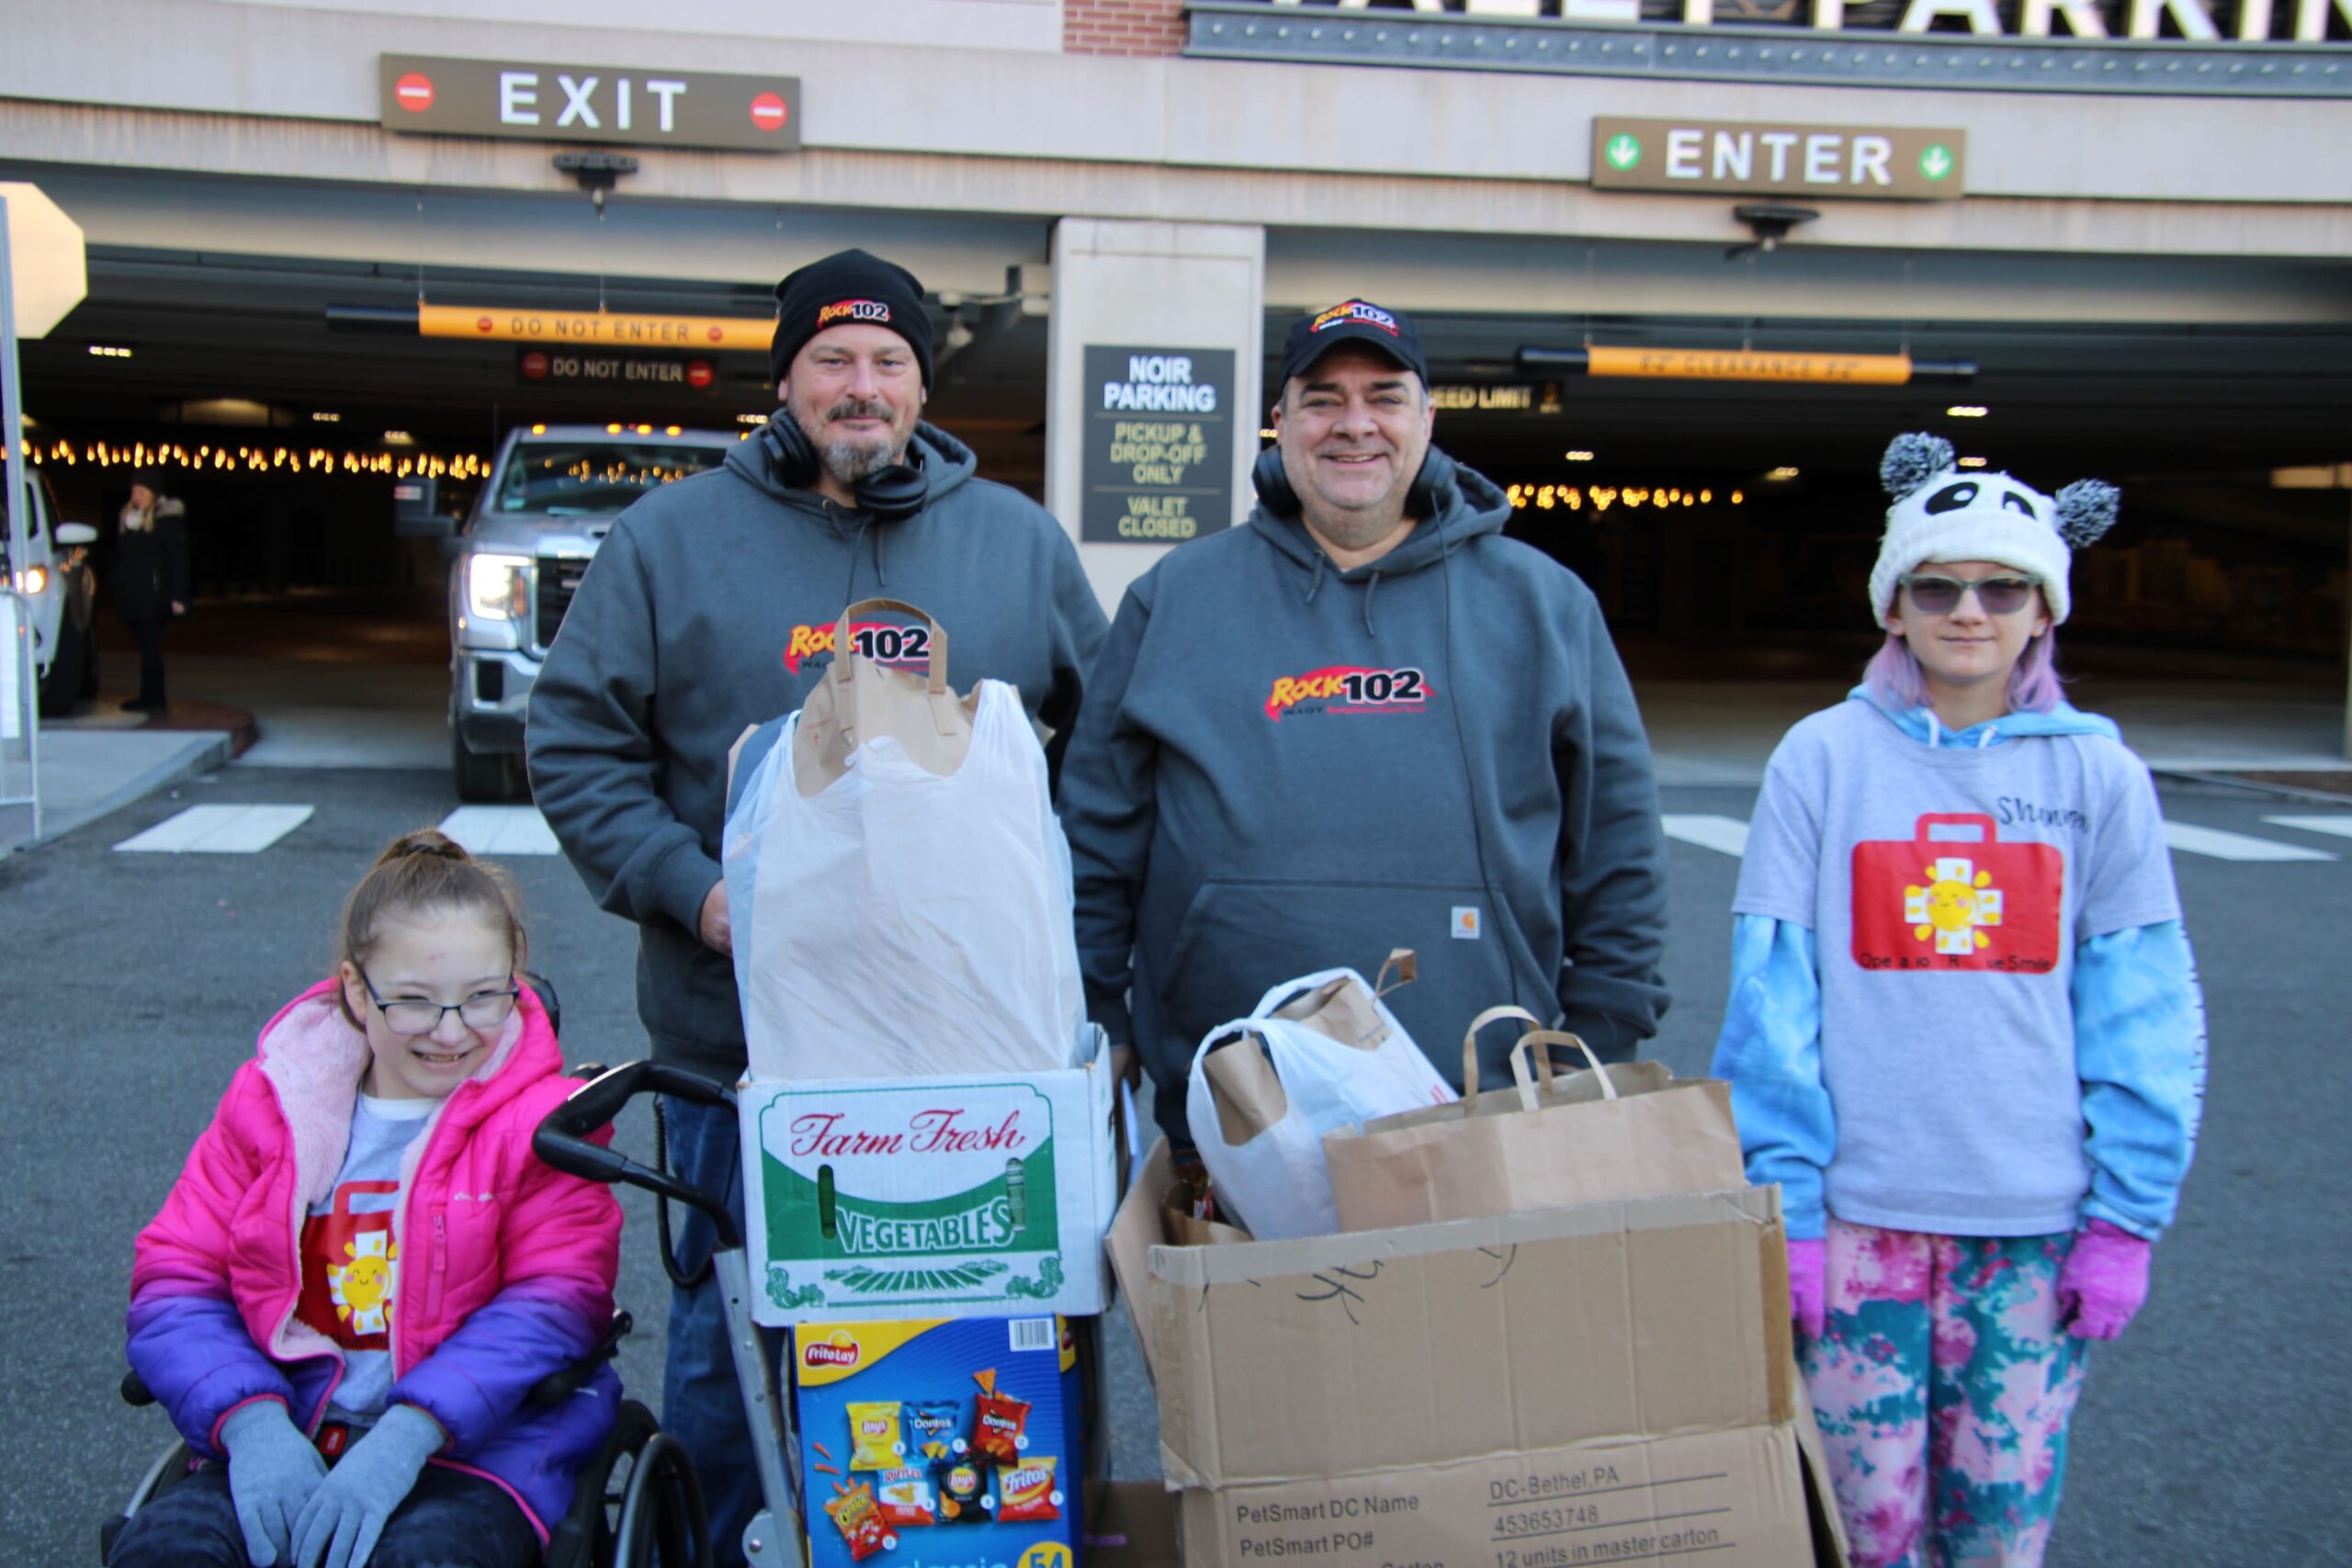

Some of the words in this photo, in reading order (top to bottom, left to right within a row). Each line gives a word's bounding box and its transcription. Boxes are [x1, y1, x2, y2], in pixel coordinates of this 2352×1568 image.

[500, 72, 686, 132] EXIT
[1666, 129, 1893, 185] ENTER
[852, 300, 888, 322] 102
[511, 318, 543, 336] DO
[556, 320, 601, 338] NOT
[615, 321, 690, 342] ENTER
[553, 361, 584, 378] DO
[589, 363, 620, 378] NOT
[625, 365, 684, 382] ENTER
[1129, 355, 1192, 384] NOIR
[1104, 382, 1216, 412] PARKING
[1479, 385, 1532, 409] LIMIT
[1114, 422, 1185, 444] PICKUP
[1188, 424, 1204, 444] &
[1110, 443, 1207, 465] DROP-OFF
[1133, 464, 1185, 484] ONLY
[1127, 496, 1189, 516] VALET
[1118, 516, 1196, 538] CLOSED
[854, 626, 930, 662] 102
[1341, 667, 1426, 705] 102
[790, 1112, 903, 1157] Farm
[910, 1108, 1025, 1154] Fresh
[834, 1196, 1014, 1255] VEGETABLES
[1005, 1468, 1049, 1494] Fritos
[1237, 1504, 1325, 1523] PetSmart
[1329, 1498, 1359, 1518] DC
[1364, 1495, 1419, 1515] Name
[1495, 1505, 1599, 1535] 453653748
[1240, 1536, 1328, 1557] PetSmart
[1333, 1531, 1374, 1551] PO#
[1497, 1551, 1515, 1568] 12
[1521, 1544, 1566, 1565] units
[1572, 1543, 1589, 1560] in
[1593, 1537, 1655, 1557] master
[1660, 1527, 1719, 1547] carton
